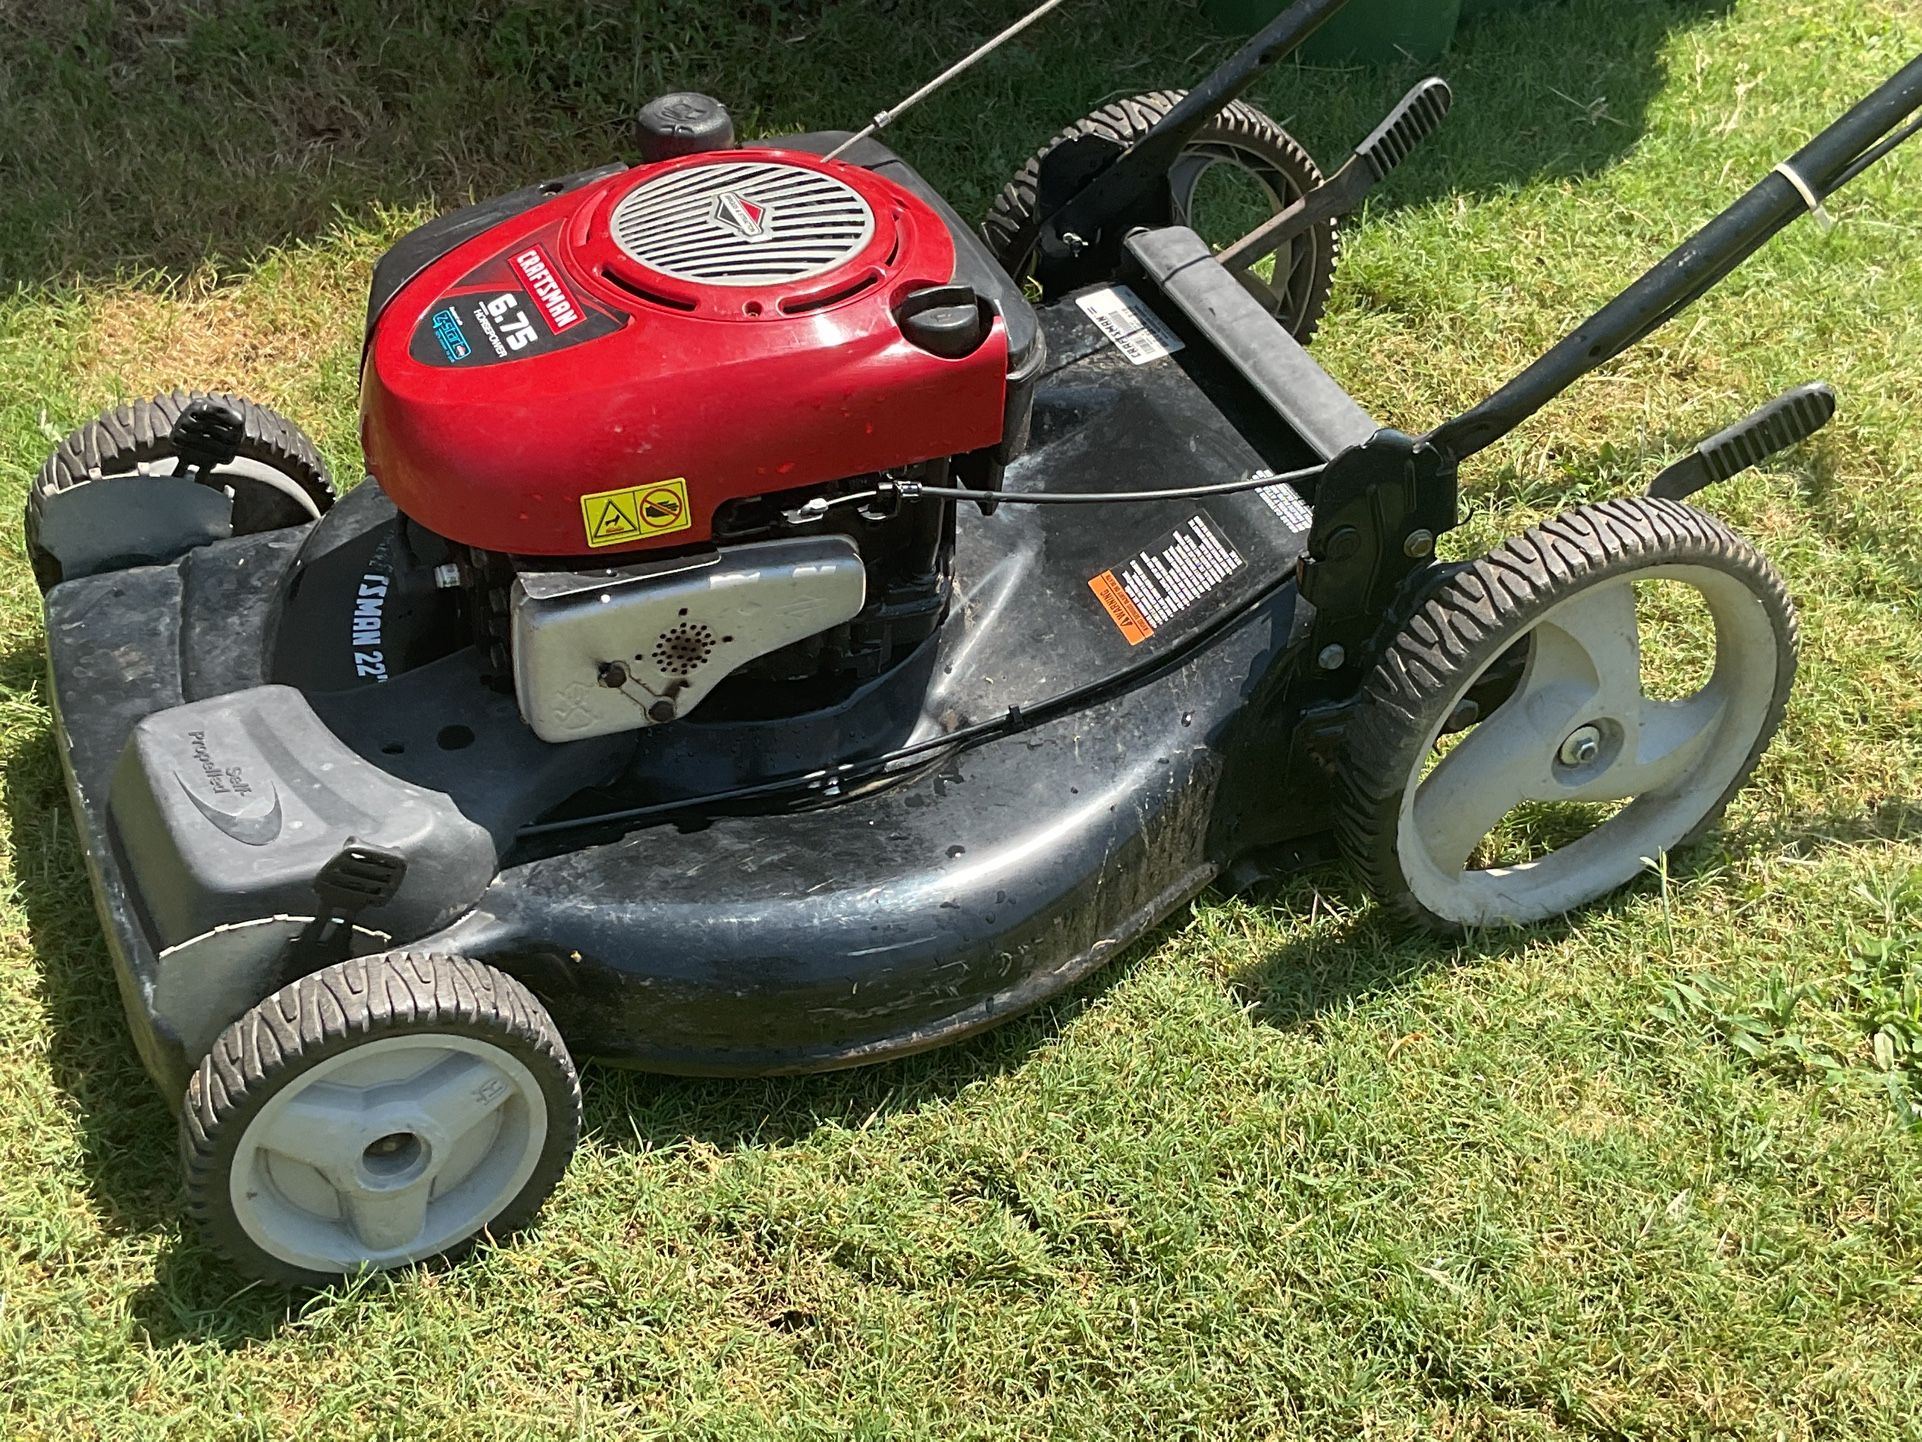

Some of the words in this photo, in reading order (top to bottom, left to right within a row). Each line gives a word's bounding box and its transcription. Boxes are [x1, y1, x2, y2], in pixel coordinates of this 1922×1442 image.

[516, 249, 577, 327] CRAFTSMAN
[473, 308, 507, 357] HORSEPOWER
[485, 293, 538, 352] 6.75
[1096, 315, 1141, 358] CRAFTSMAN
[1099, 589, 1125, 620] WARNING
[188, 730, 230, 795] Propelled
[226, 766, 252, 798] Self-
